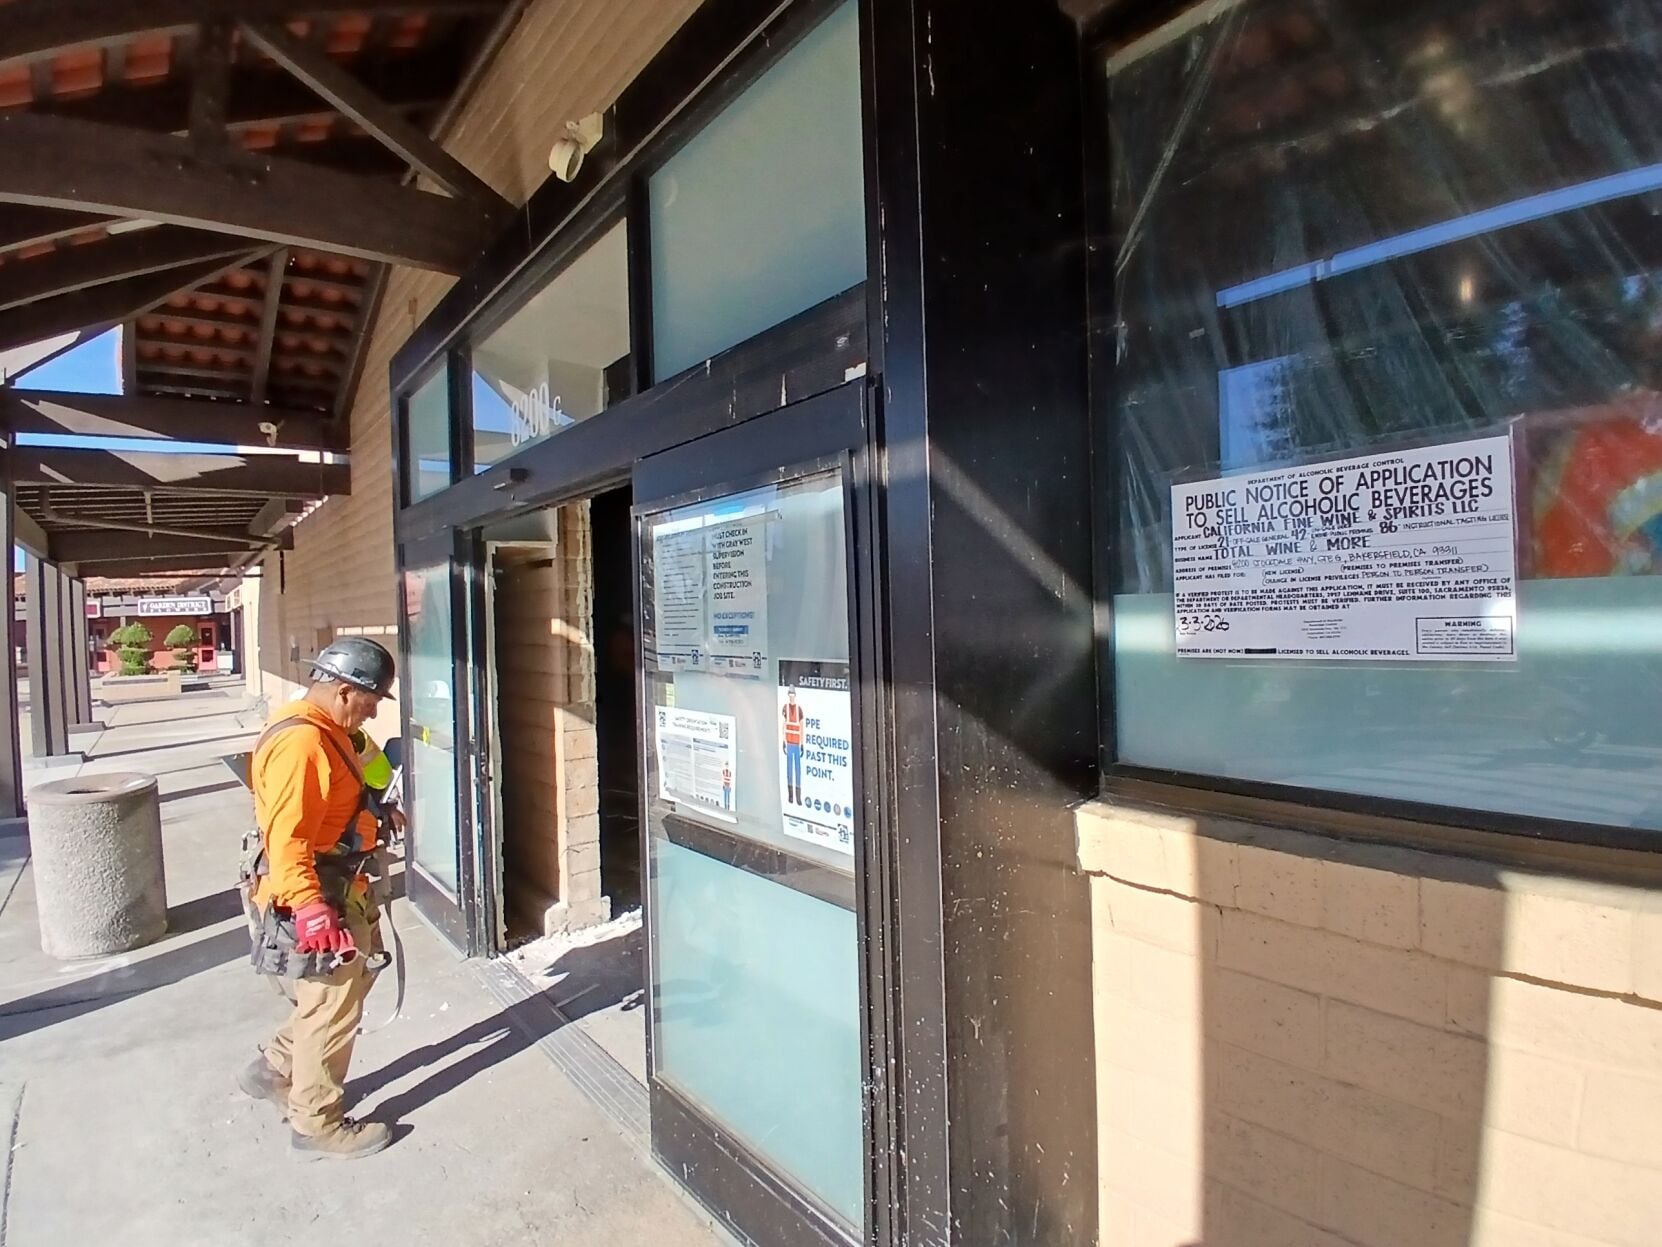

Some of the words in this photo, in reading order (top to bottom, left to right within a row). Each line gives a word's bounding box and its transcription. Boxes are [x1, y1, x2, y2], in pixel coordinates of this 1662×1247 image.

[512, 382, 549, 447] 8200
[1248, 475, 1284, 485] DEPARTMENT
[1299, 468, 1333, 478] ALCOHOLIC
[1336, 463, 1369, 472] BEVERAGE
[1373, 458, 1404, 467] CONTROL
[1186, 490, 1236, 511] PUBLIC
[1246, 480, 1308, 504] NOTICE
[1319, 475, 1344, 495] OF
[1356, 455, 1492, 491] APPLICATION
[1186, 512, 1207, 528] TO
[1216, 507, 1248, 525] SELL
[1257, 493, 1360, 522] ALCOHOLIC
[1372, 477, 1493, 509] BEVERAGES
[1203, 521, 1275, 538] CALIFORNIA
[1284, 516, 1314, 530] FINE
[1320, 512, 1361, 527] WINE
[1368, 509, 1376, 521] &
[1383, 502, 1444, 520] SPIRITS
[1453, 499, 1479, 513] LLC
[726, 529, 741, 538] CHECK
[1214, 545, 1254, 560] TOTAL
[1266, 542, 1301, 556] WINE
[1310, 540, 1318, 552] &
[1327, 536, 1371, 551] MORE
[1413, 548, 1426, 558] CA
[1432, 546, 1458, 555] 93311
[713, 581, 752, 590] CONSTRUCTION
[799, 676, 825, 687] SAFETY
[825, 677, 848, 689] FIRST.
[805, 718, 821, 730] PPE
[805, 734, 849, 751] REQUIRED
[806, 750, 826, 763] PAST
[828, 753, 847, 767] THIS
[806, 766, 835, 782] POINT.
